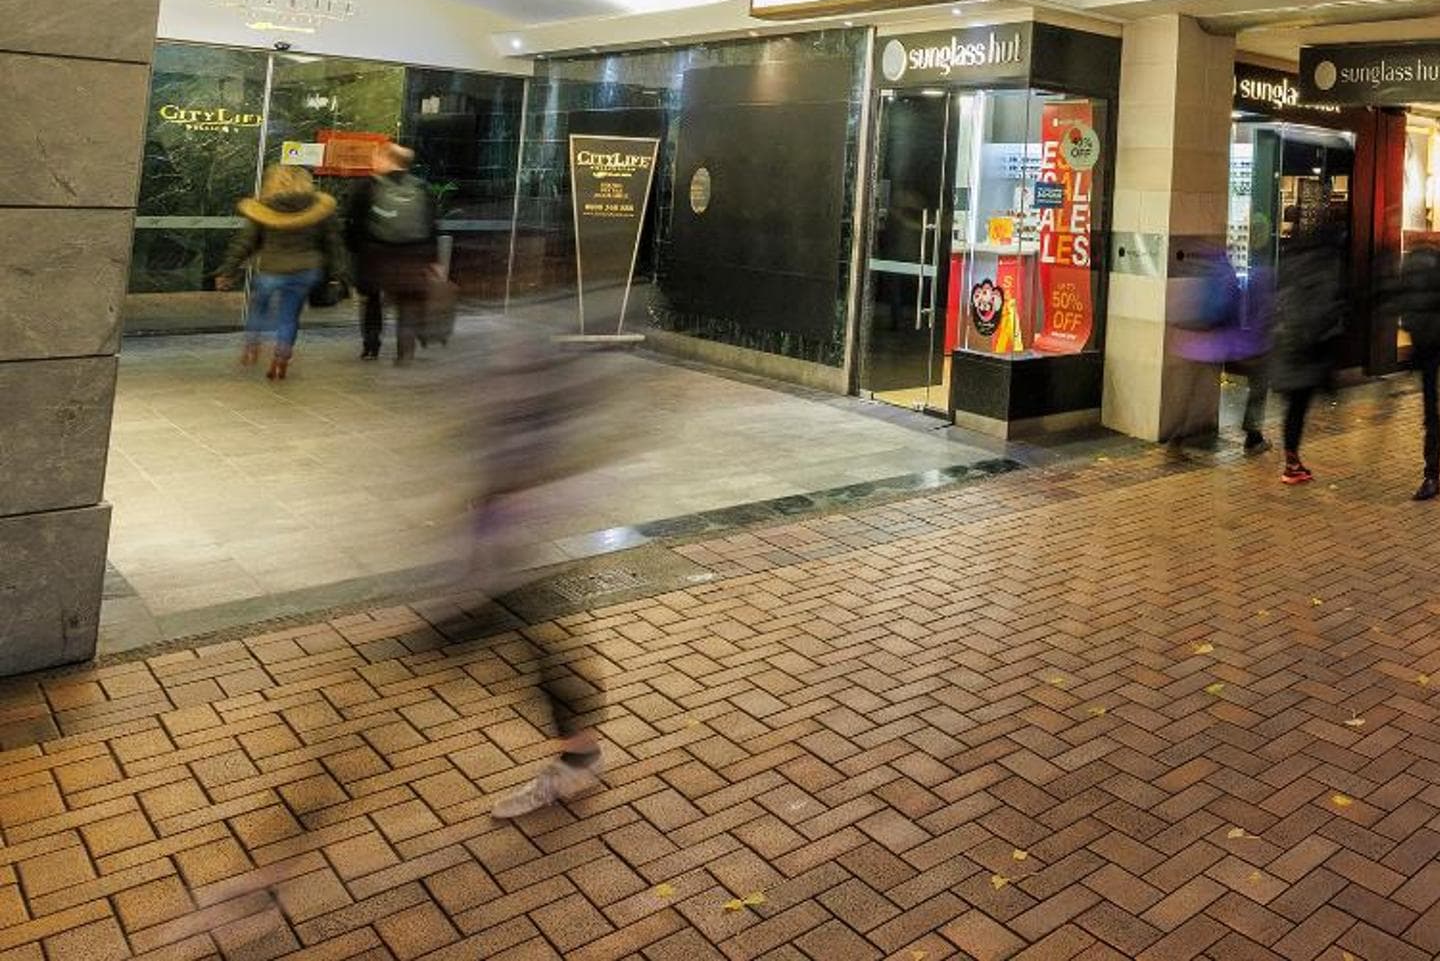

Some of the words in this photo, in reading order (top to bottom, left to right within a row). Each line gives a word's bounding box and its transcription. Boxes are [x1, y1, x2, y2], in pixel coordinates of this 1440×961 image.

[909, 35, 987, 75] sunglass
[988, 31, 1022, 64] hut
[1340, 59, 1415, 88] sunglass
[1240, 78, 1299, 110] sungla
[577, 150, 652, 168] CITYLIFE
[1053, 290, 1083, 312] 50%
[1053, 311, 1084, 331] OFF
